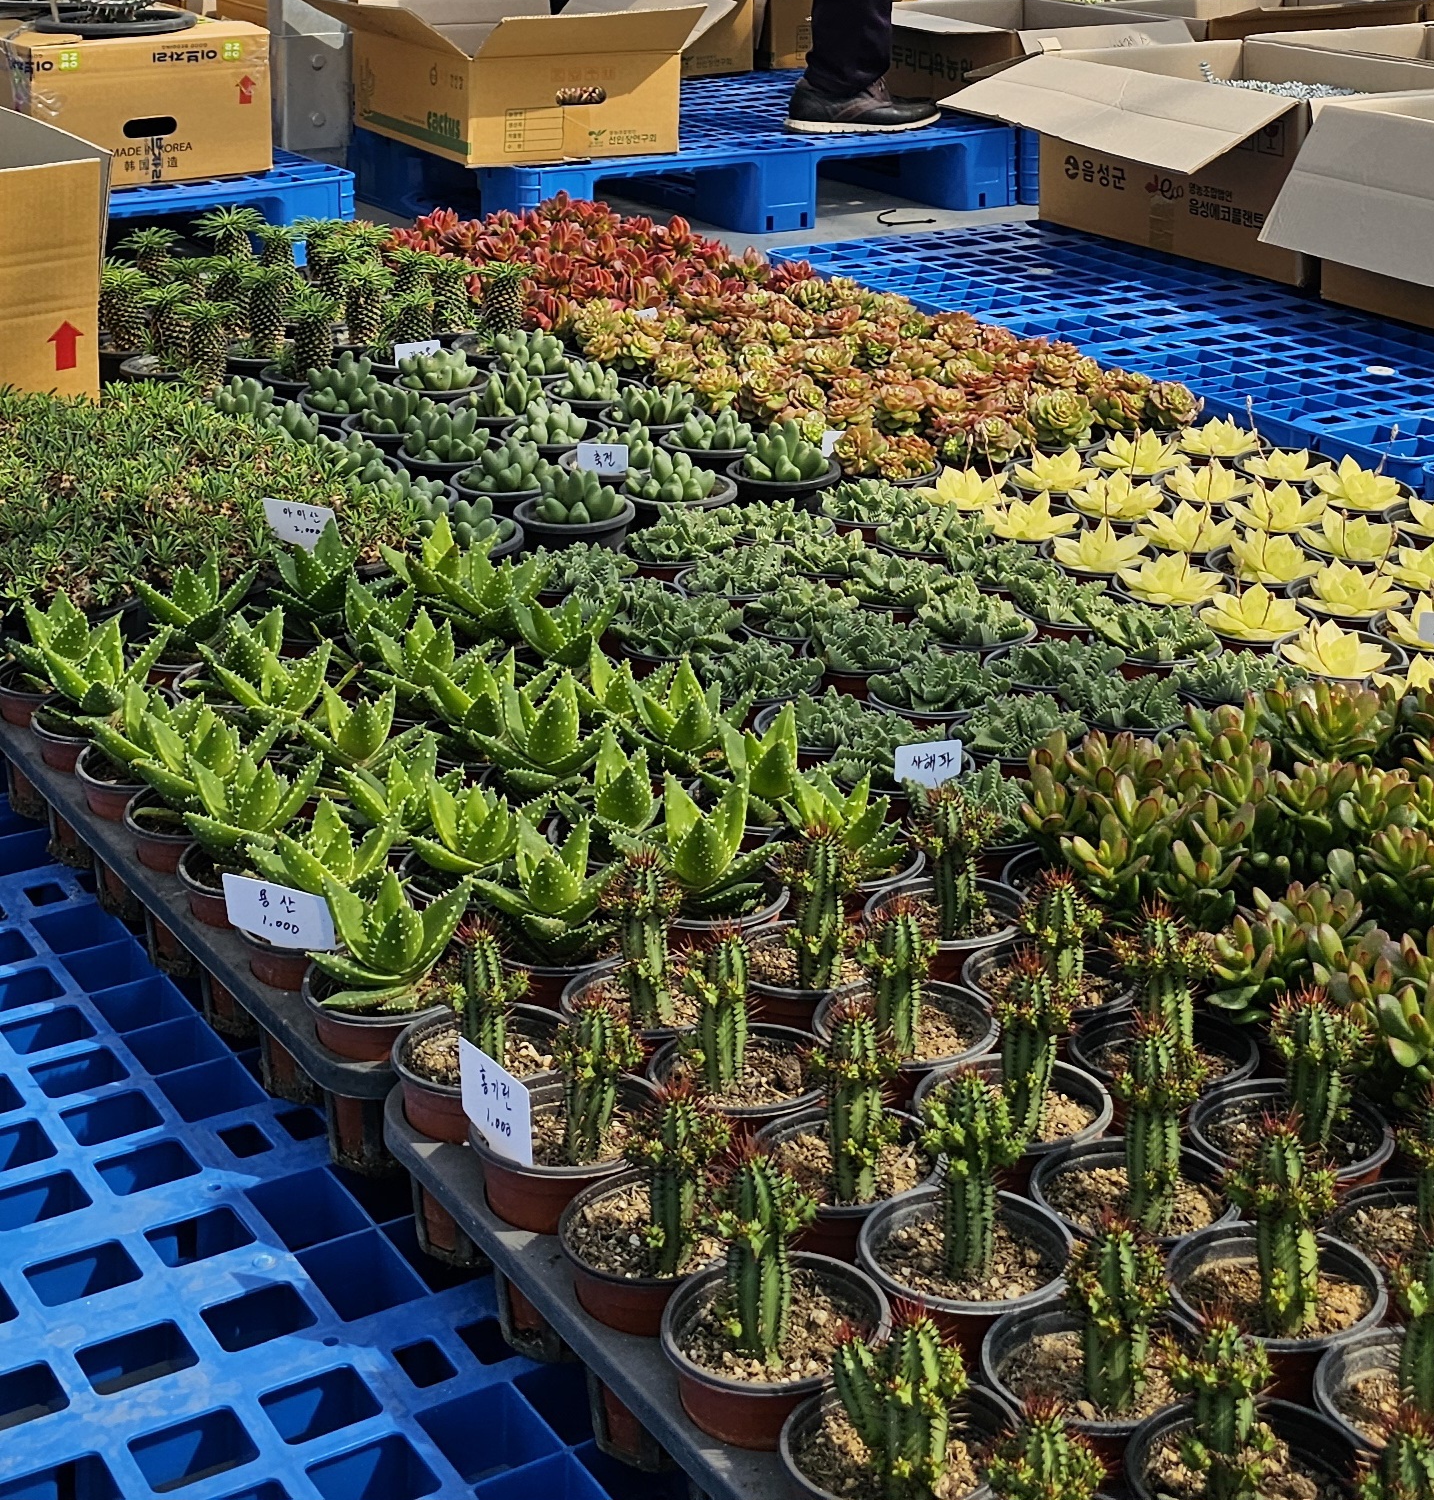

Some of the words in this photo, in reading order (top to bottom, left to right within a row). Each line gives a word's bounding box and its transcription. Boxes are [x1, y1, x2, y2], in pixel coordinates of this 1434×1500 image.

[152, 49, 218, 64] 이브자리
[426, 110, 461, 140] cactus
[608, 133, 658, 146] 선인장연구회
[1081, 159, 1127, 191] 음성군
[1159, 177, 1184, 200] eco
[1188, 198, 1265, 230] 음성에코플랜트
[262, 914, 300, 935] 1.000
[479, 1063, 512, 1112] 홍기린
[486, 1107, 512, 1138] 1.000
